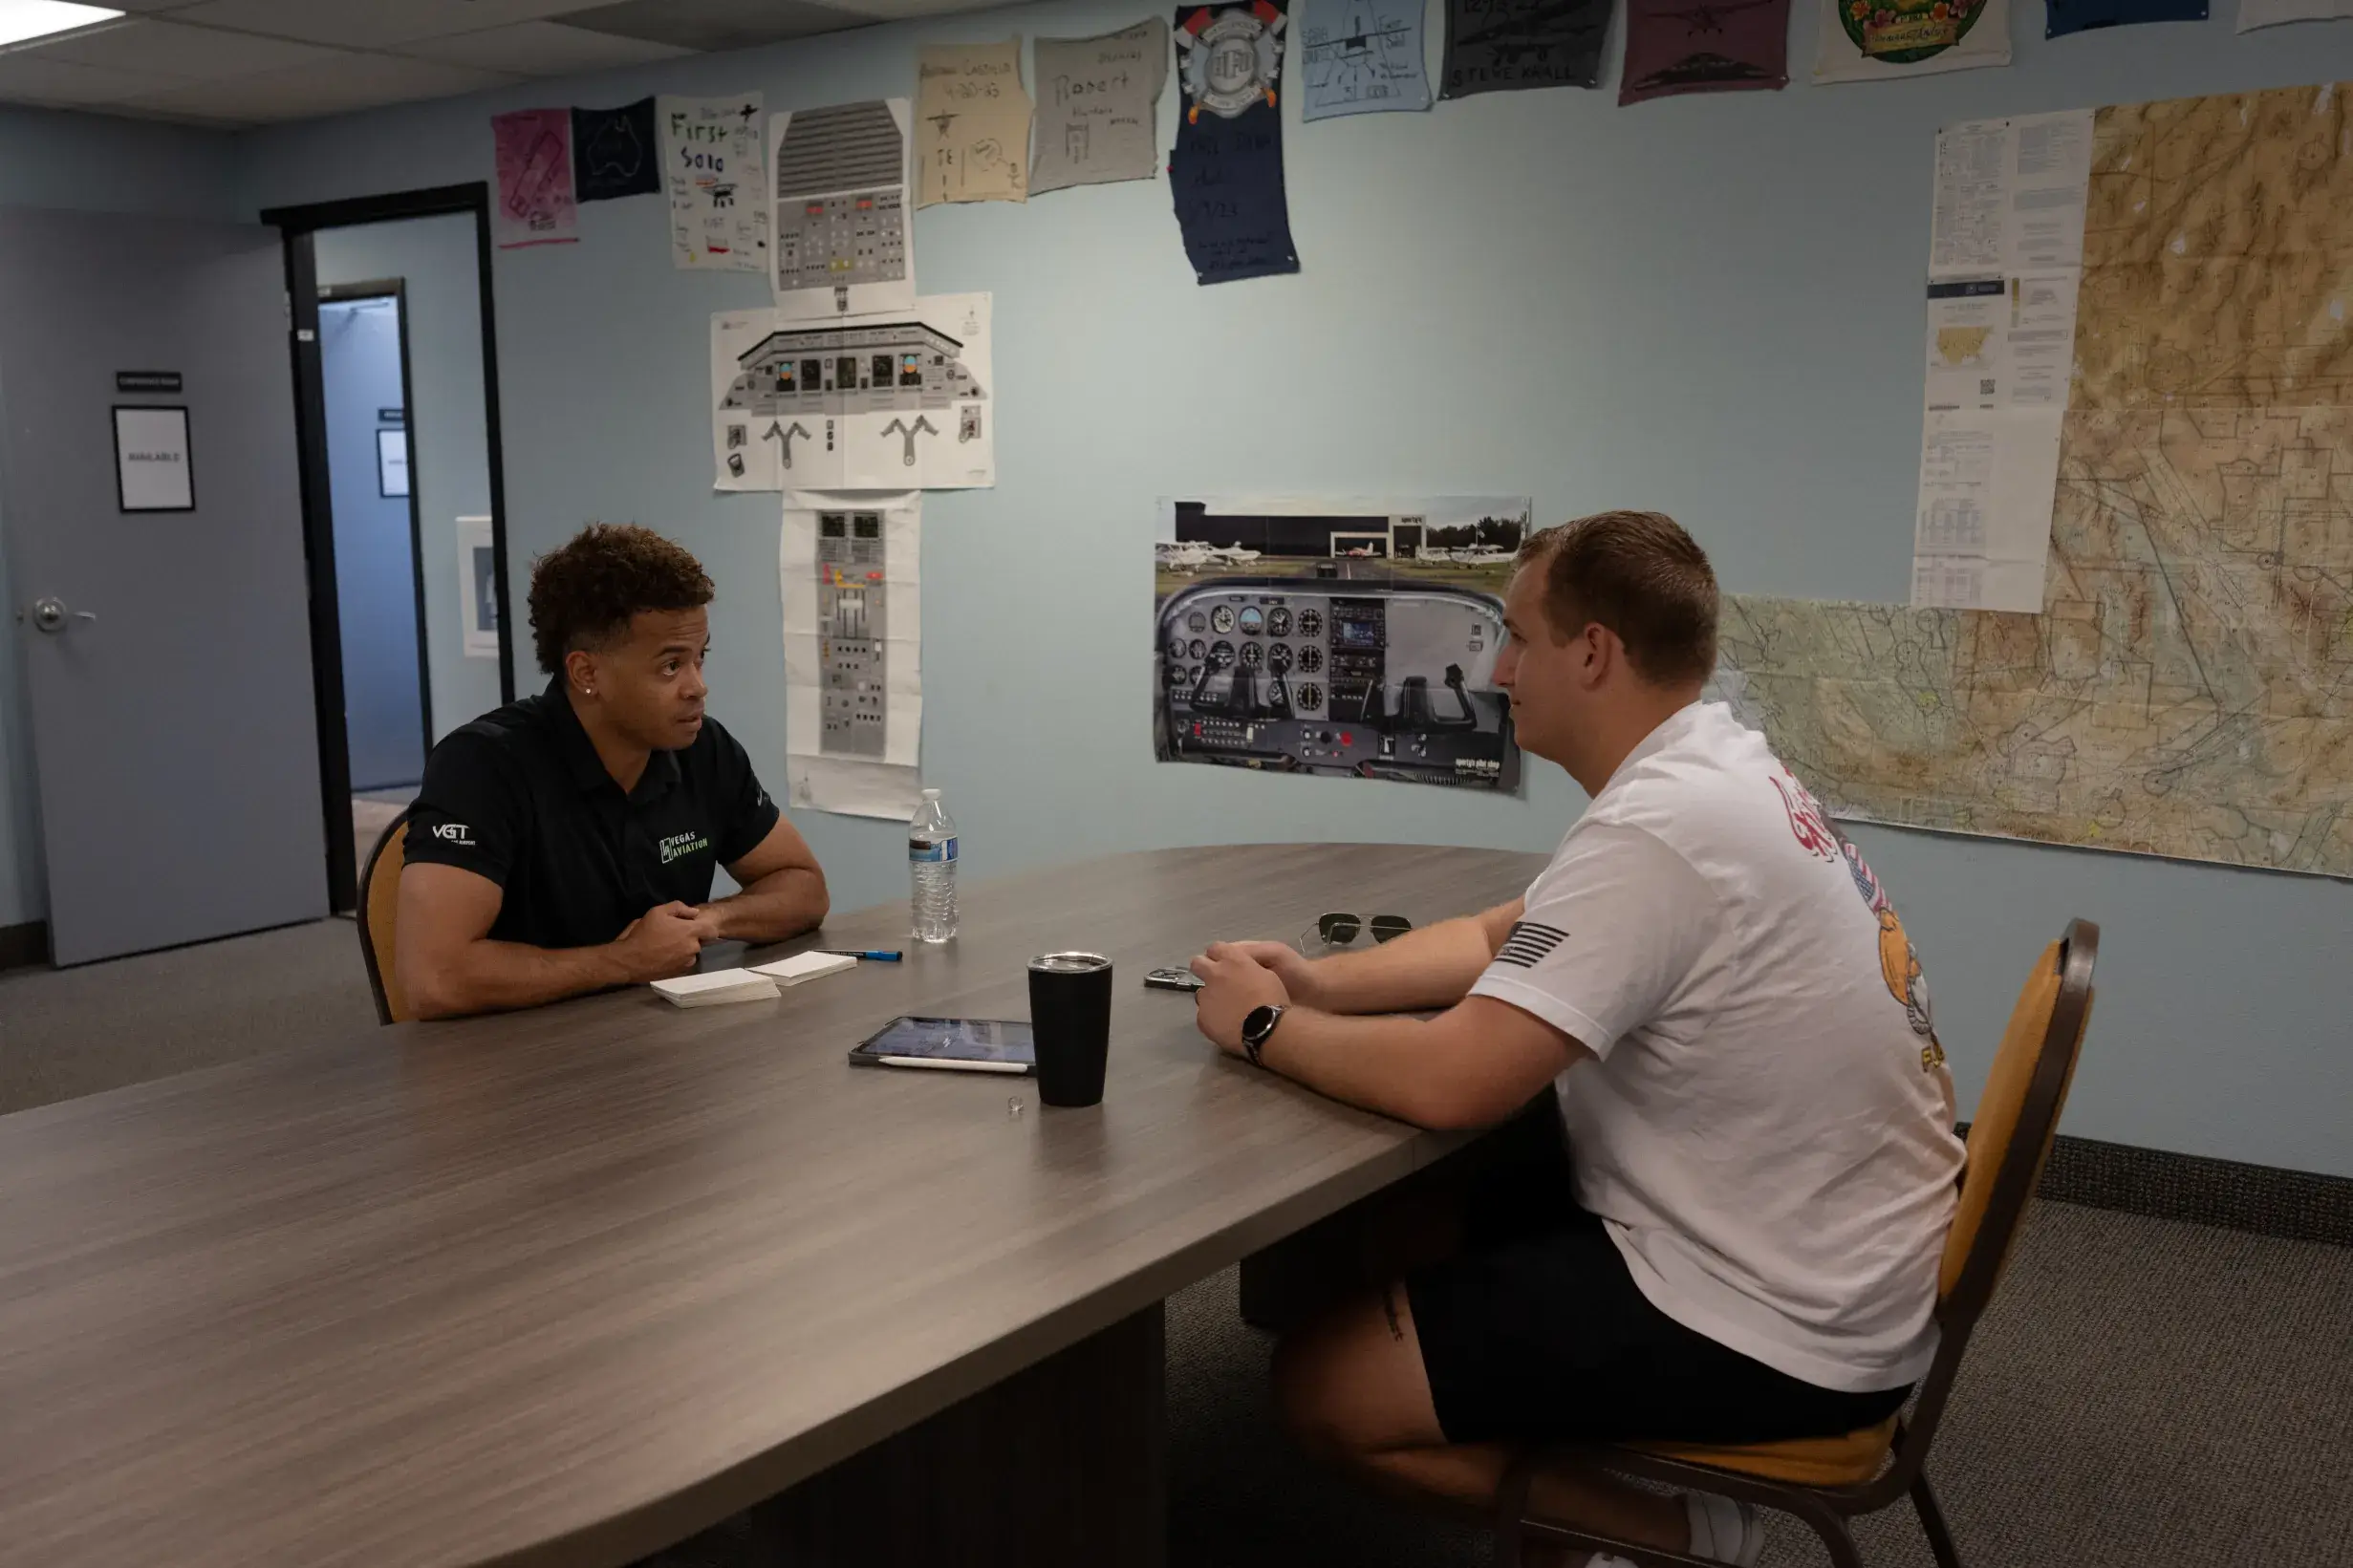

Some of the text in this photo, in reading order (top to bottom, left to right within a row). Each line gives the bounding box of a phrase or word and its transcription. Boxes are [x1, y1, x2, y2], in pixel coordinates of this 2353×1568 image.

[671, 112, 728, 143] First
[680, 146, 723, 172] Solo
[432, 824, 470, 839] VGT
[671, 831, 696, 847] VEGAS
[673, 837, 708, 857] AVIATION
